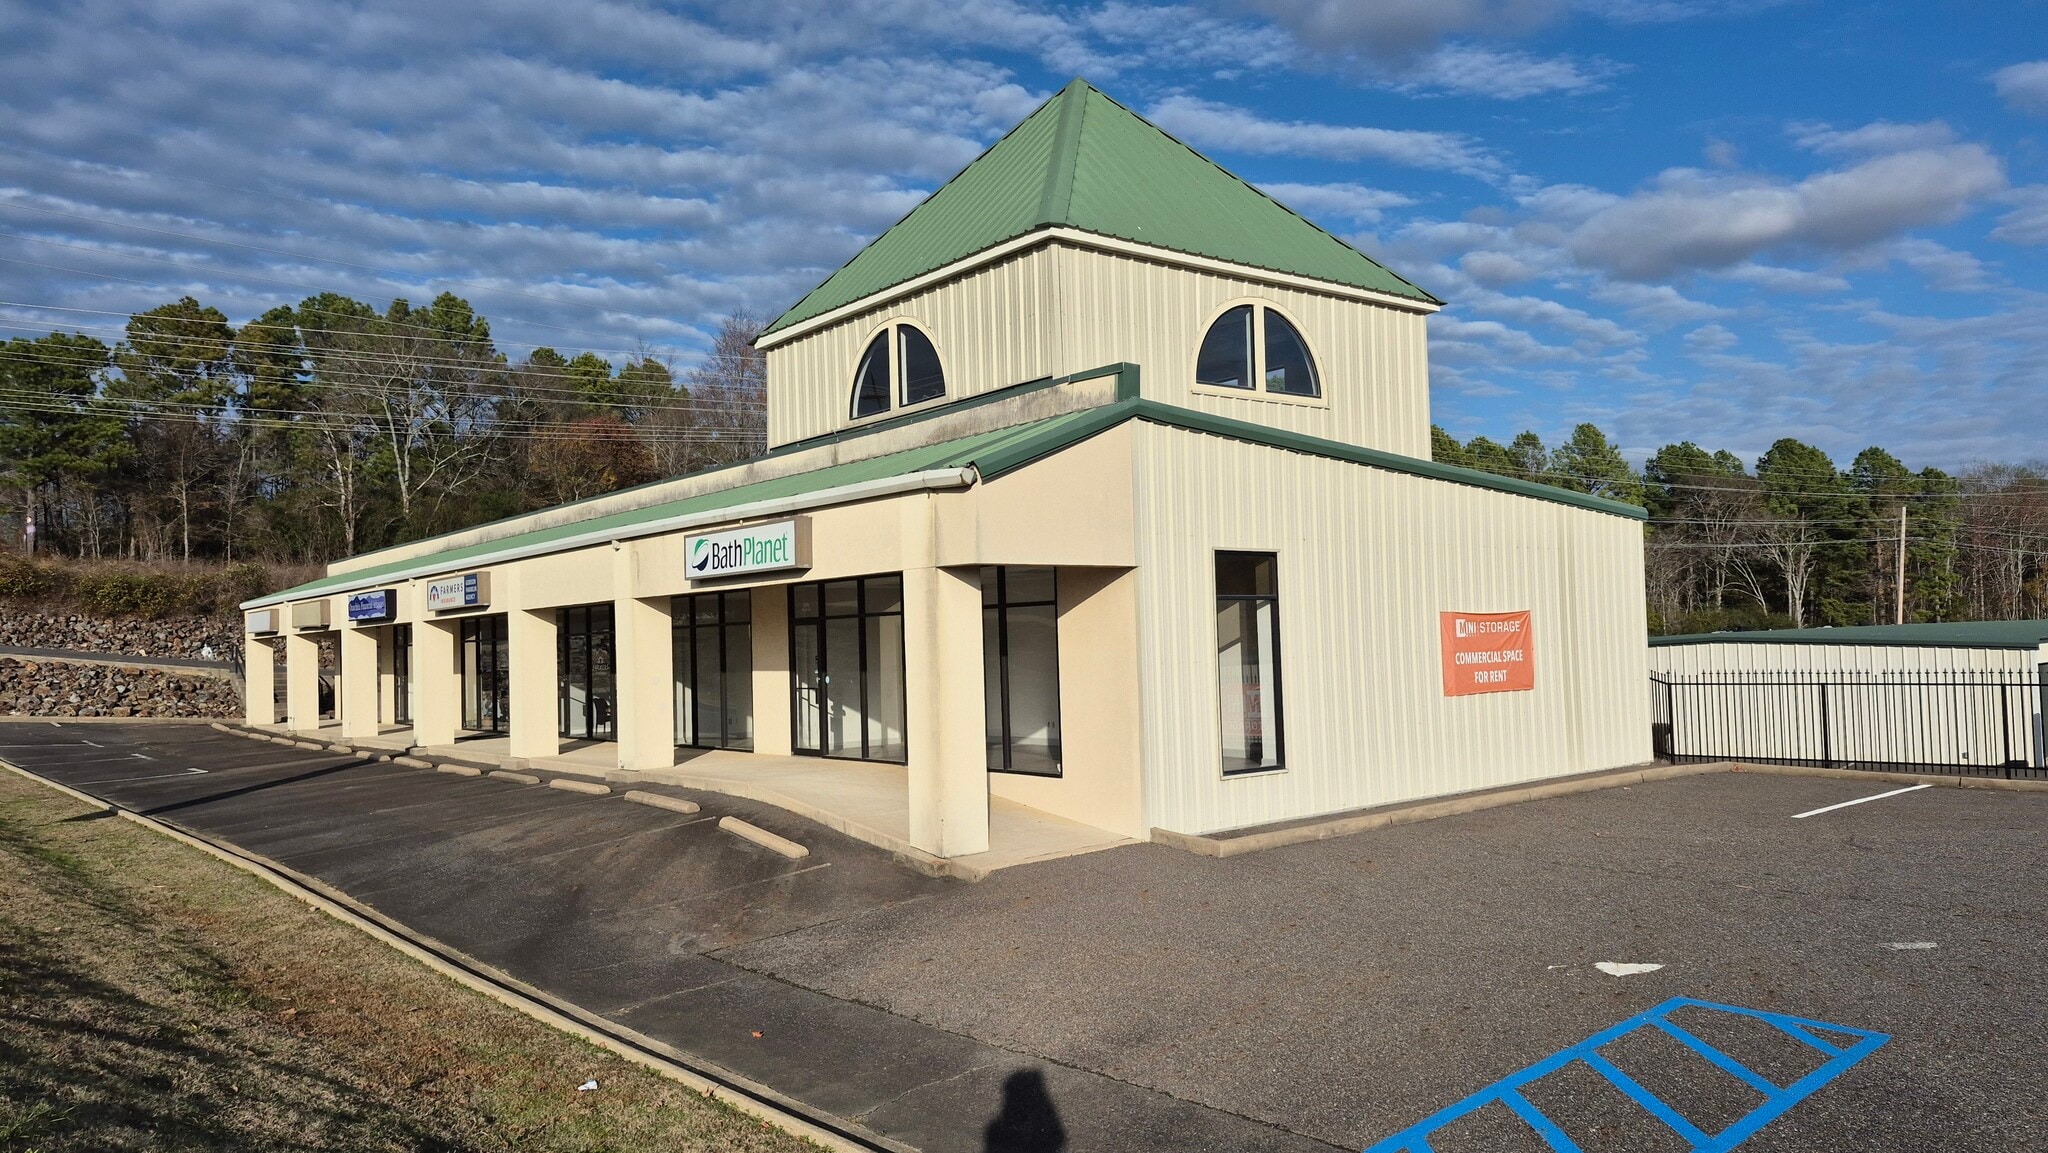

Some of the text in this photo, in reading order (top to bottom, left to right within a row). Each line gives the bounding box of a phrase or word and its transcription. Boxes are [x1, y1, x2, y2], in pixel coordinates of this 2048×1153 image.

[440, 583, 463, 595] FARMERS
[1480, 621, 1520, 633] STORAGE
[1455, 650, 1523, 665] COMMERCIAL SPACE
[1474, 670, 1507, 683] FOR RENT
